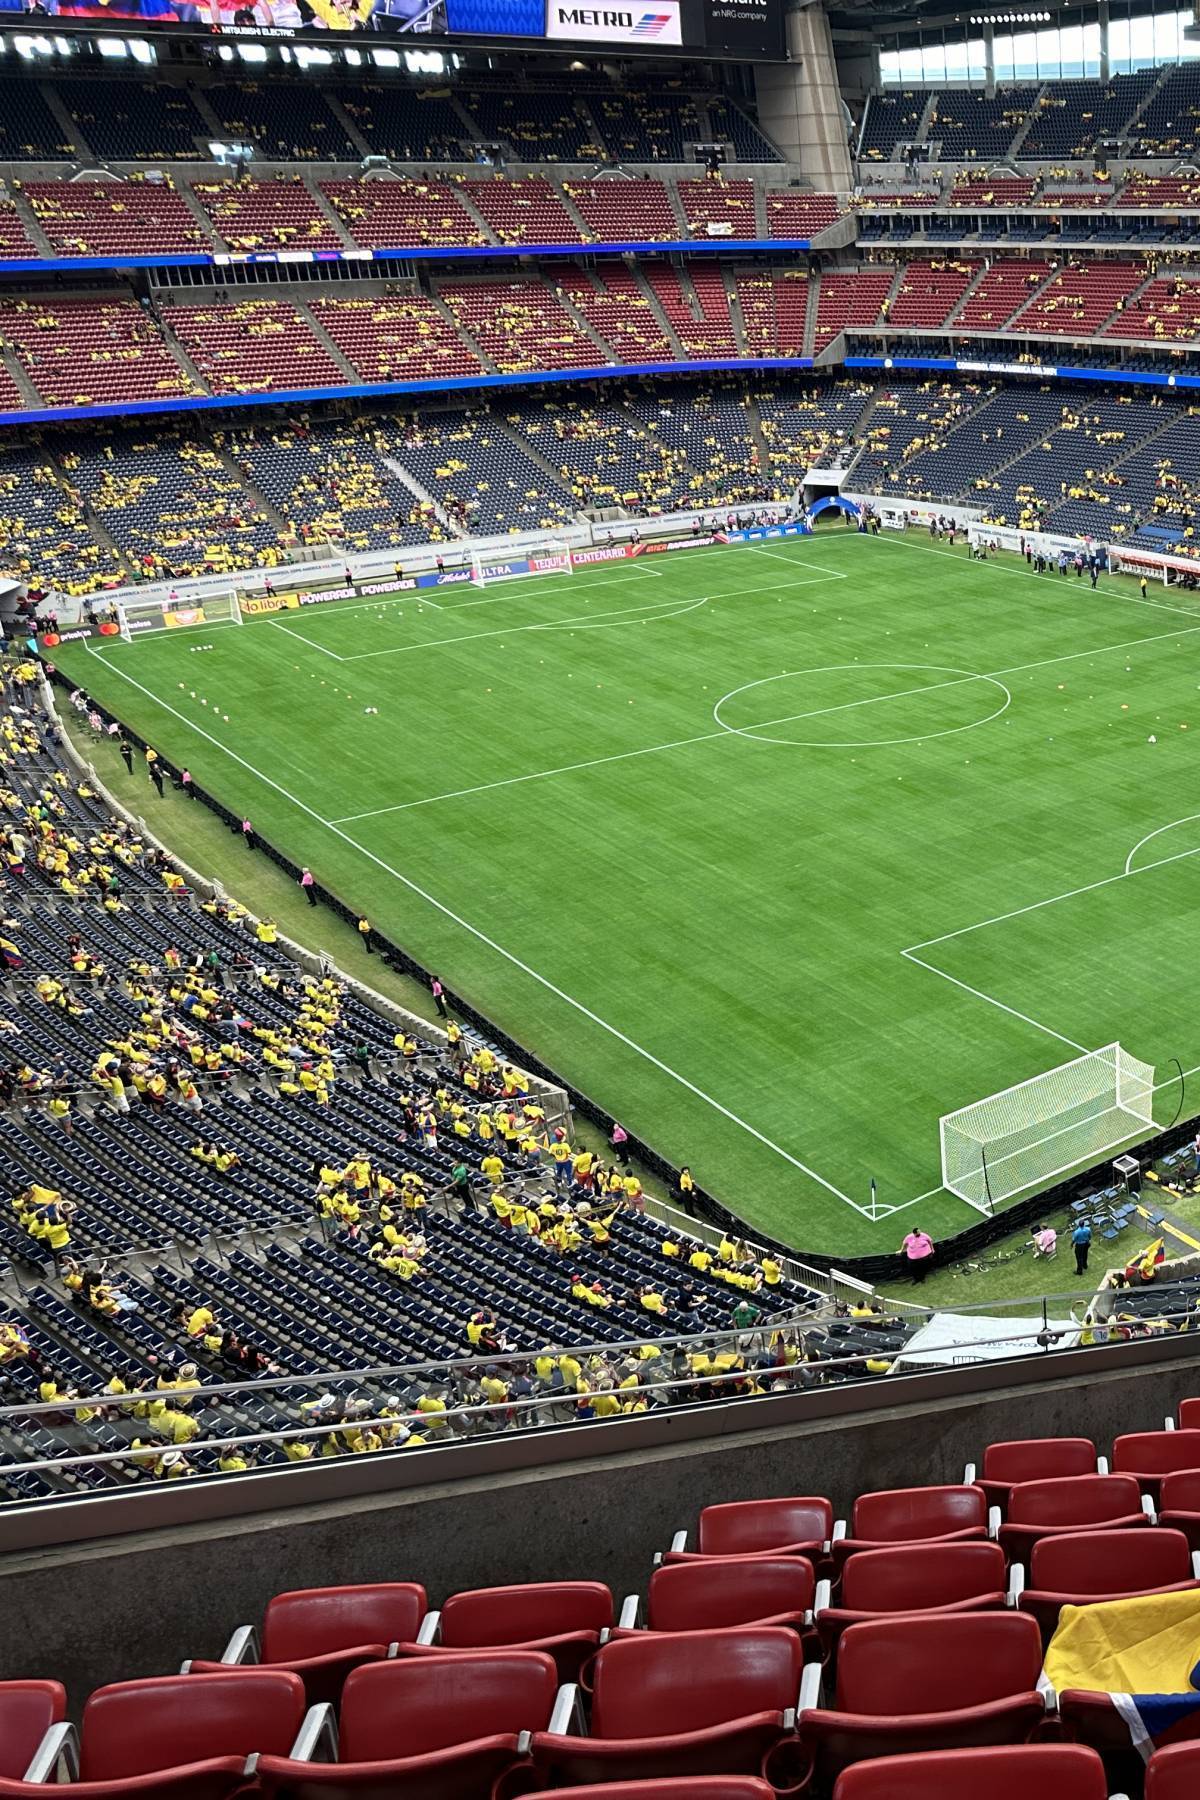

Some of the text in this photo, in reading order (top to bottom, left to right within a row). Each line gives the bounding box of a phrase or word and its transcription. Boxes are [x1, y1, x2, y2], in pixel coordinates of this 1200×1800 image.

[557, 8, 633, 28] METRO
[721, 9, 737, 18] NRG
[737, 12, 767, 22] company
[221, 26, 295, 37] MITSUBISHI ELECTRIC
[533, 547, 626, 570] TEQUILA CENTENARIO
[300, 579, 416, 605] POWERADE POWERADE
[260, 599, 288, 611] libre
